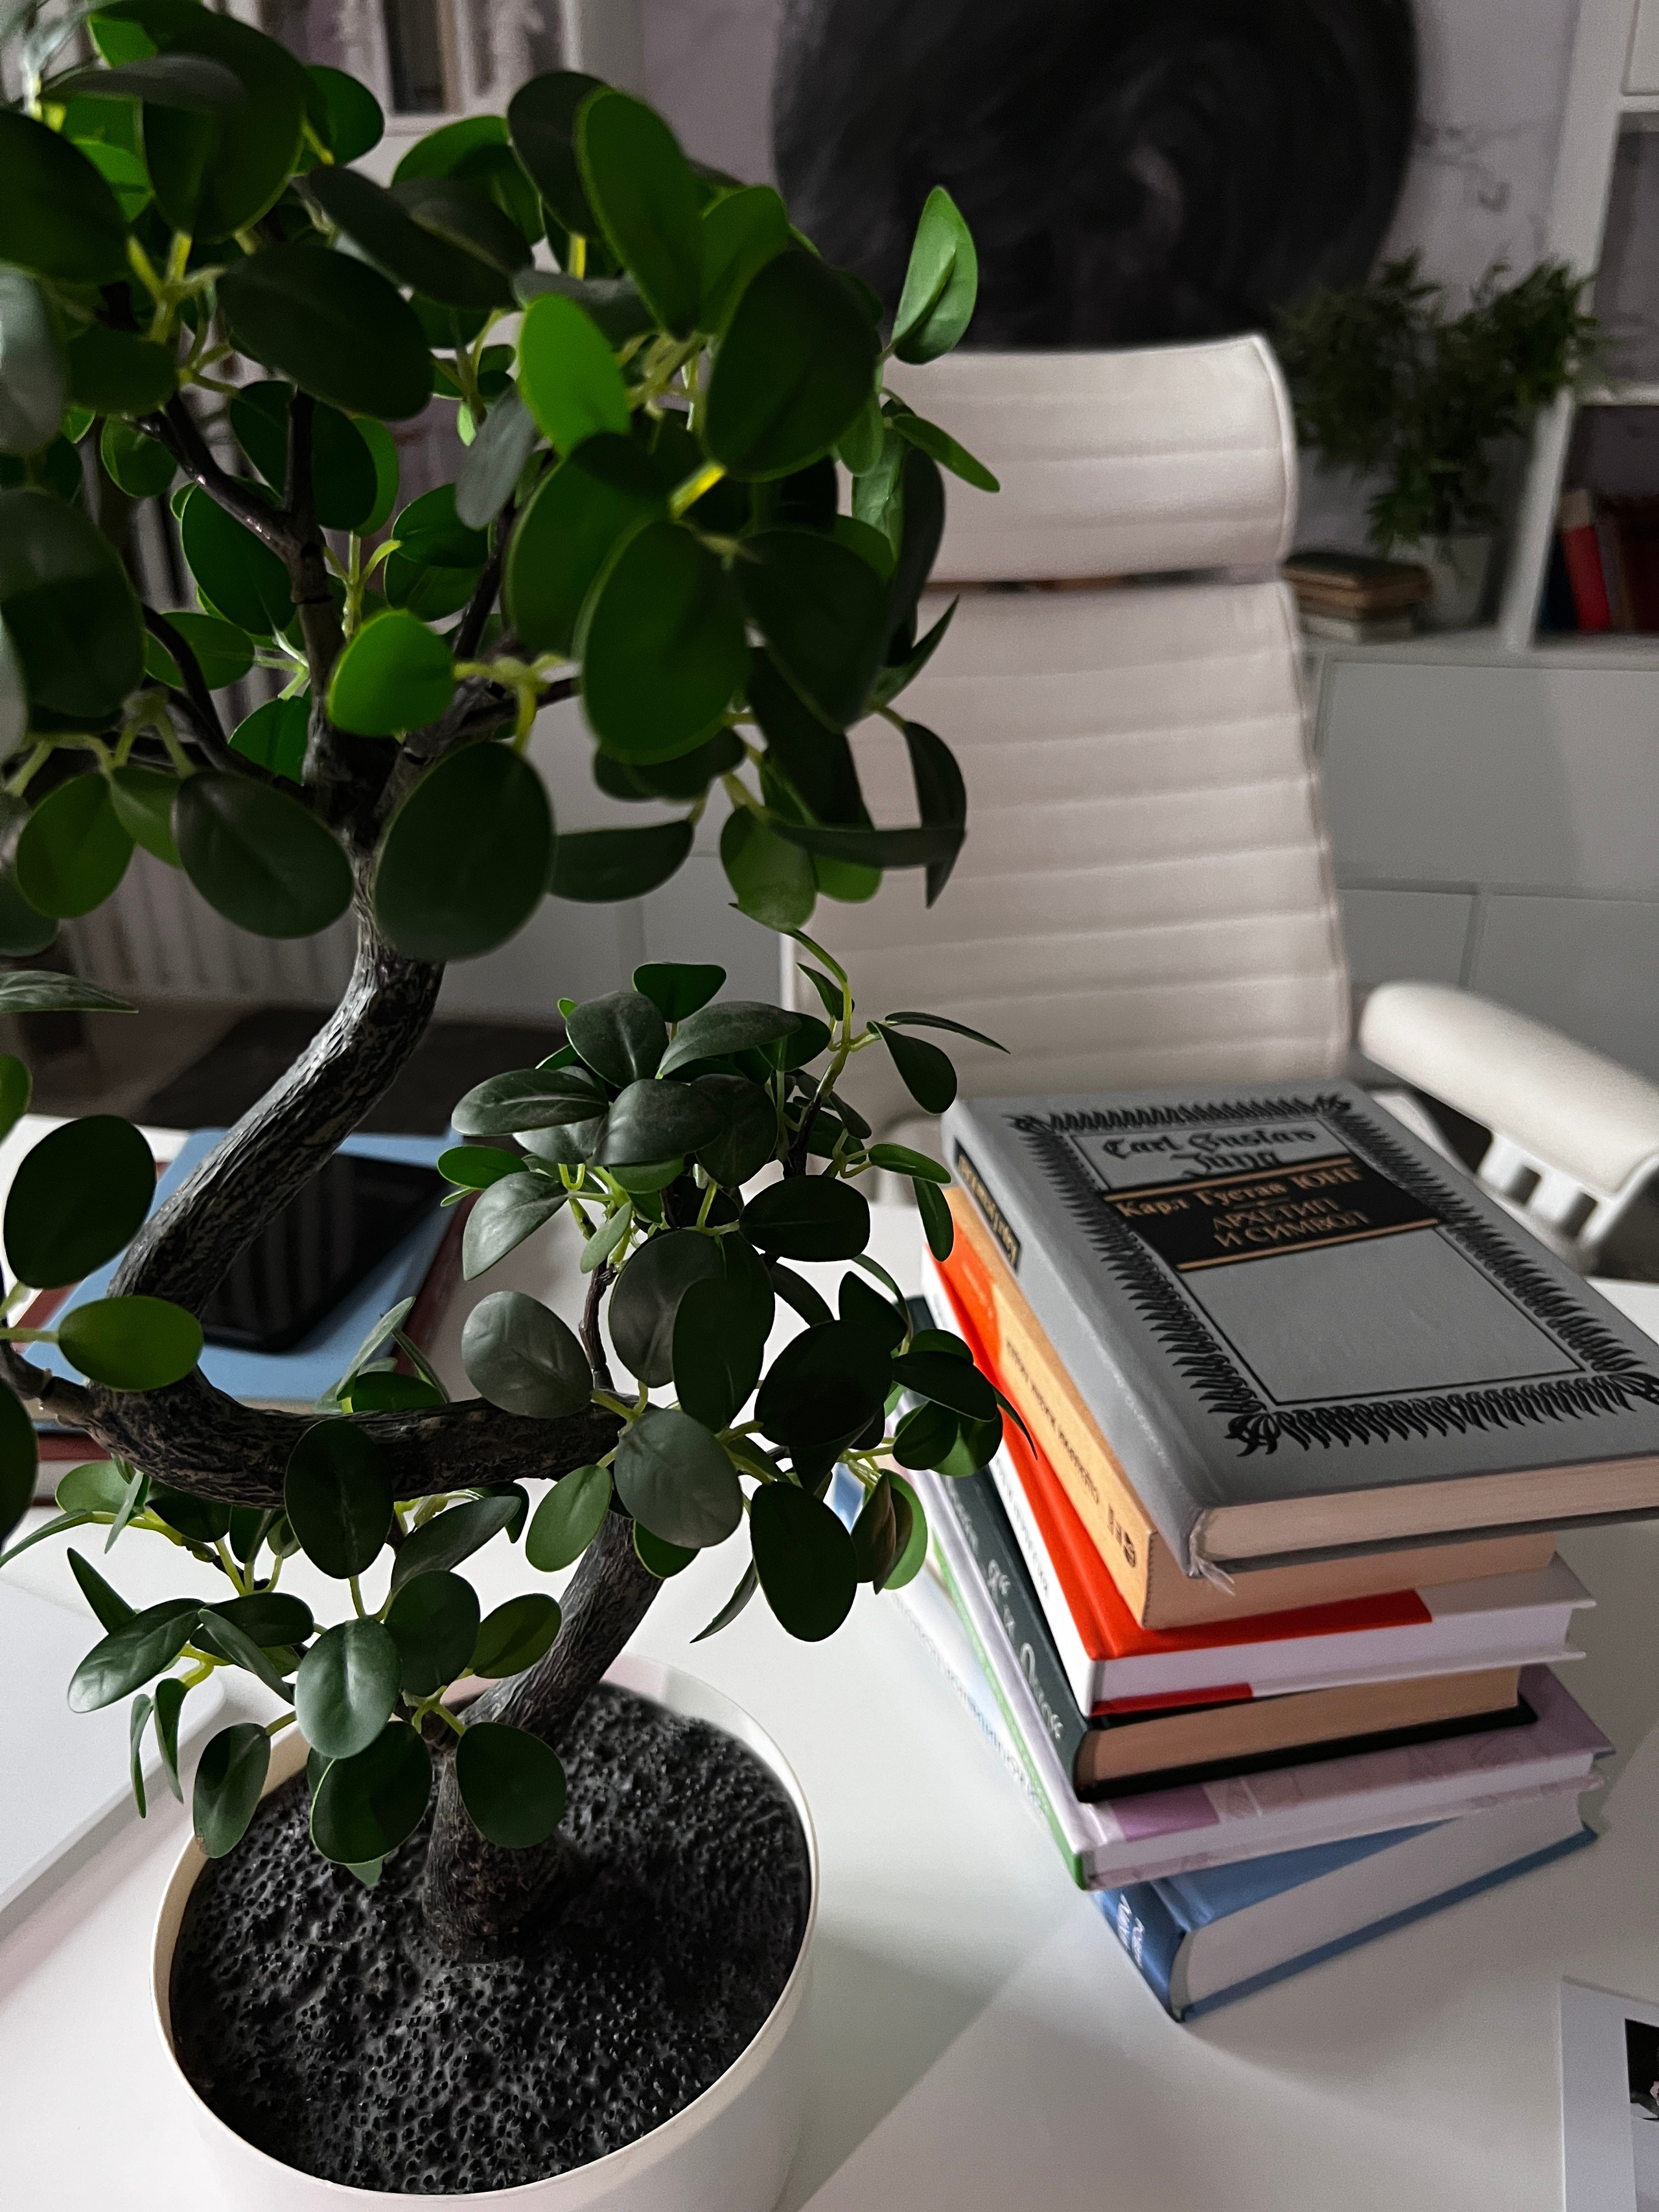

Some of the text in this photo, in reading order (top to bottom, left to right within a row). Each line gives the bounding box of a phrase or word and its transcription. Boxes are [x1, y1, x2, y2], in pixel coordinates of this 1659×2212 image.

[1103, 1129, 1317, 1159] Carl Gustav
[1114, 1167, 1362, 1218] Карл Густав ЮНГ
[1212, 1196, 1341, 1231] АРХЕТИП
[1213, 1209, 1370, 1248] И СИМВОЛ
